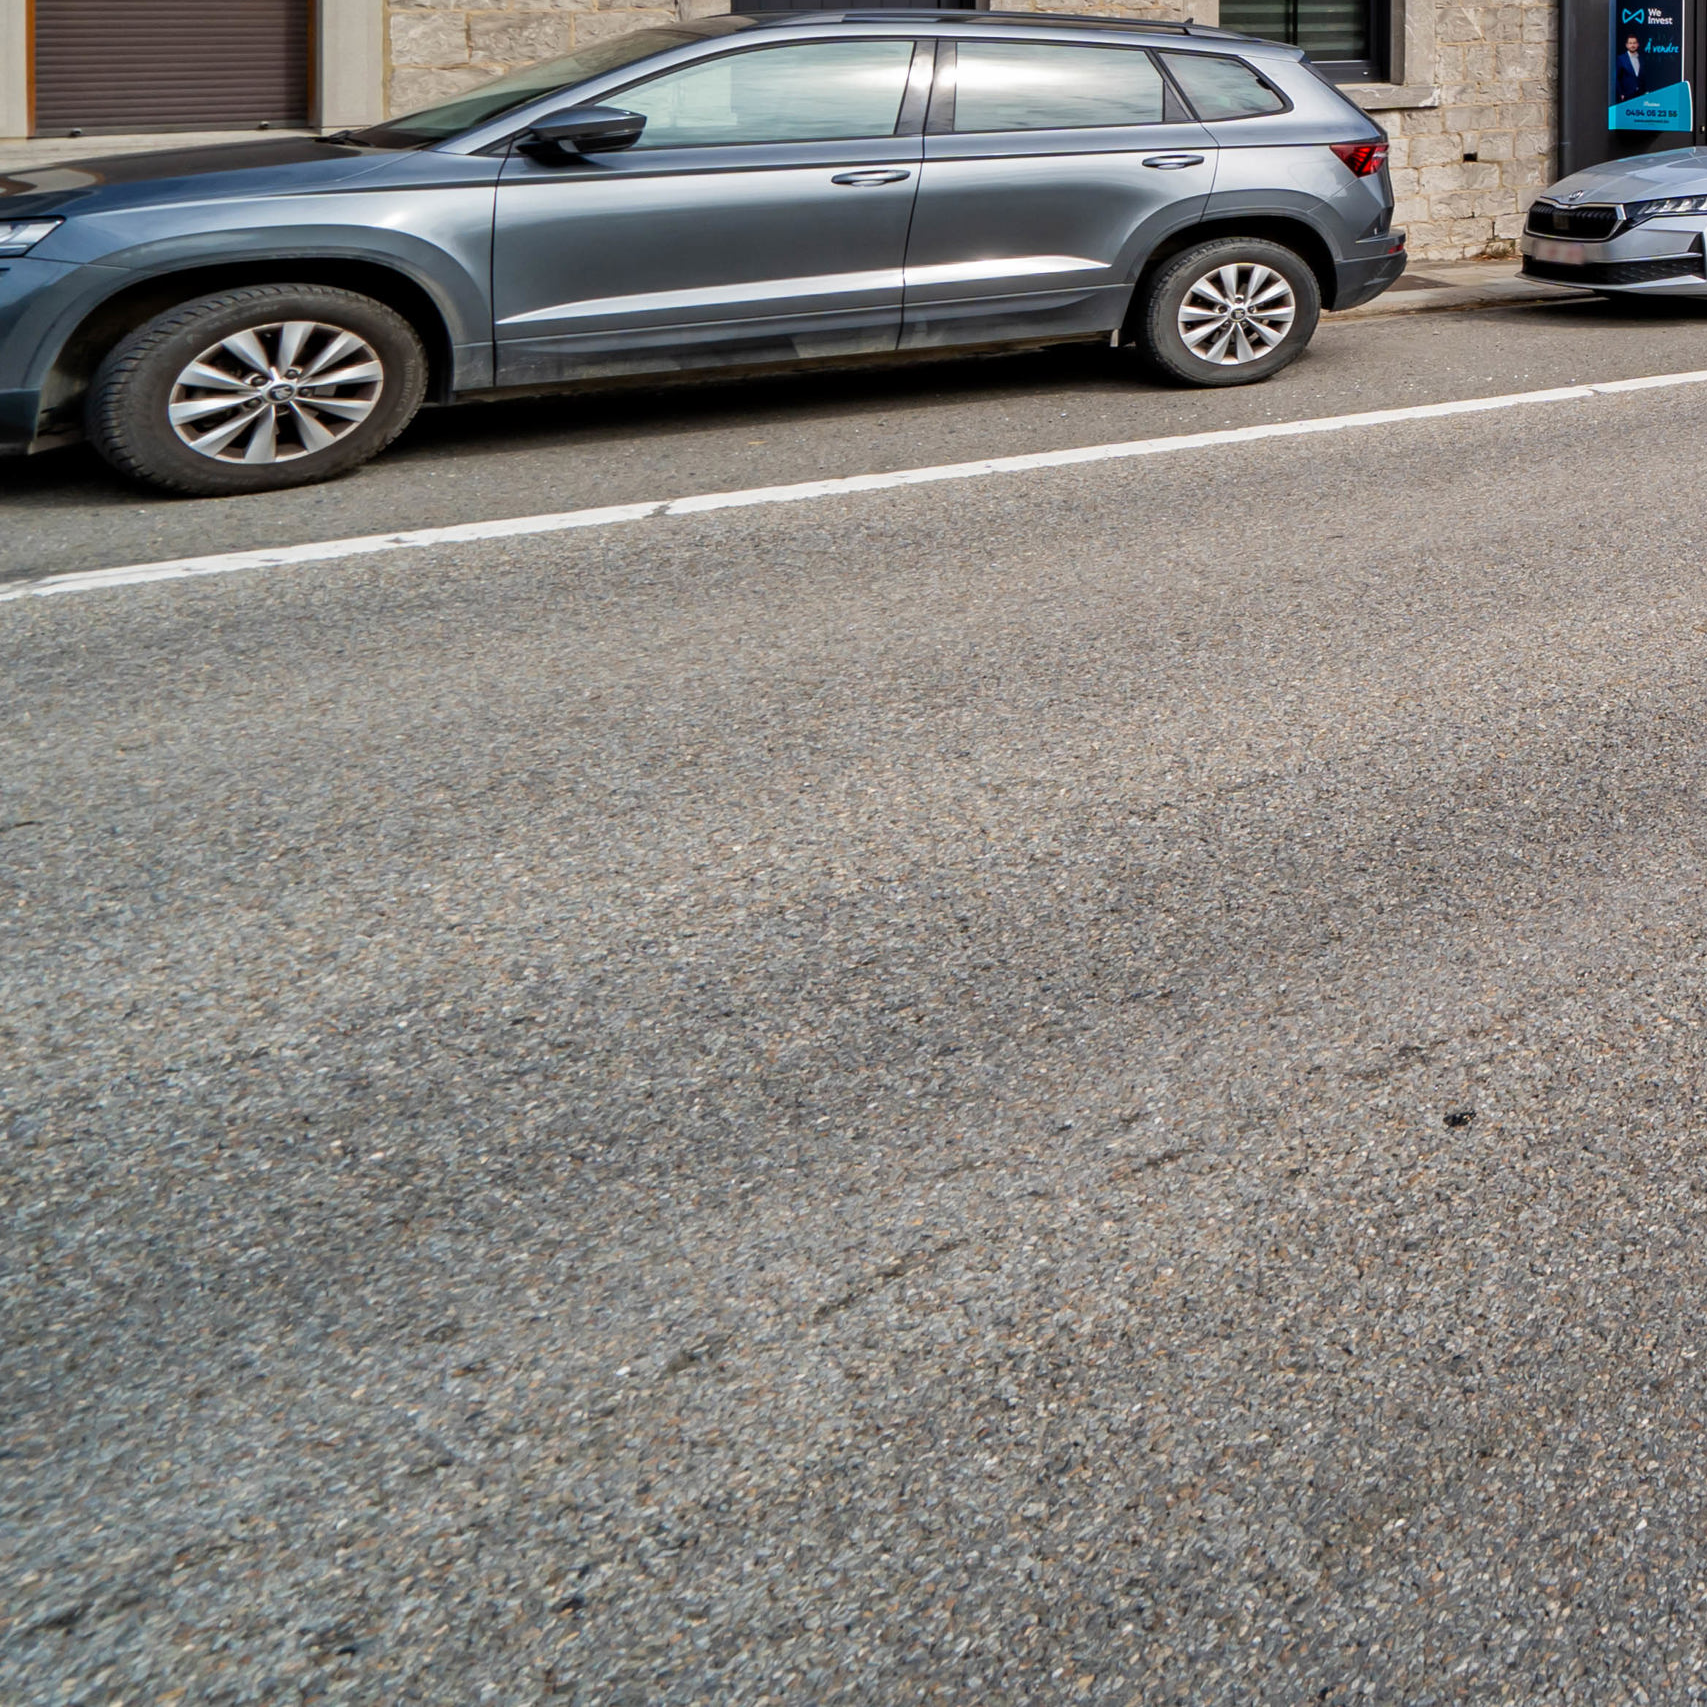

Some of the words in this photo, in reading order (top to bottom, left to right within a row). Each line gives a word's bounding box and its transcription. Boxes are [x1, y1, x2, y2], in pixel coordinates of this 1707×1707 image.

[1648, 8, 1662, 17] We
[1648, 17, 1673, 25] Invest
[1653, 42, 1680, 53] vendre
